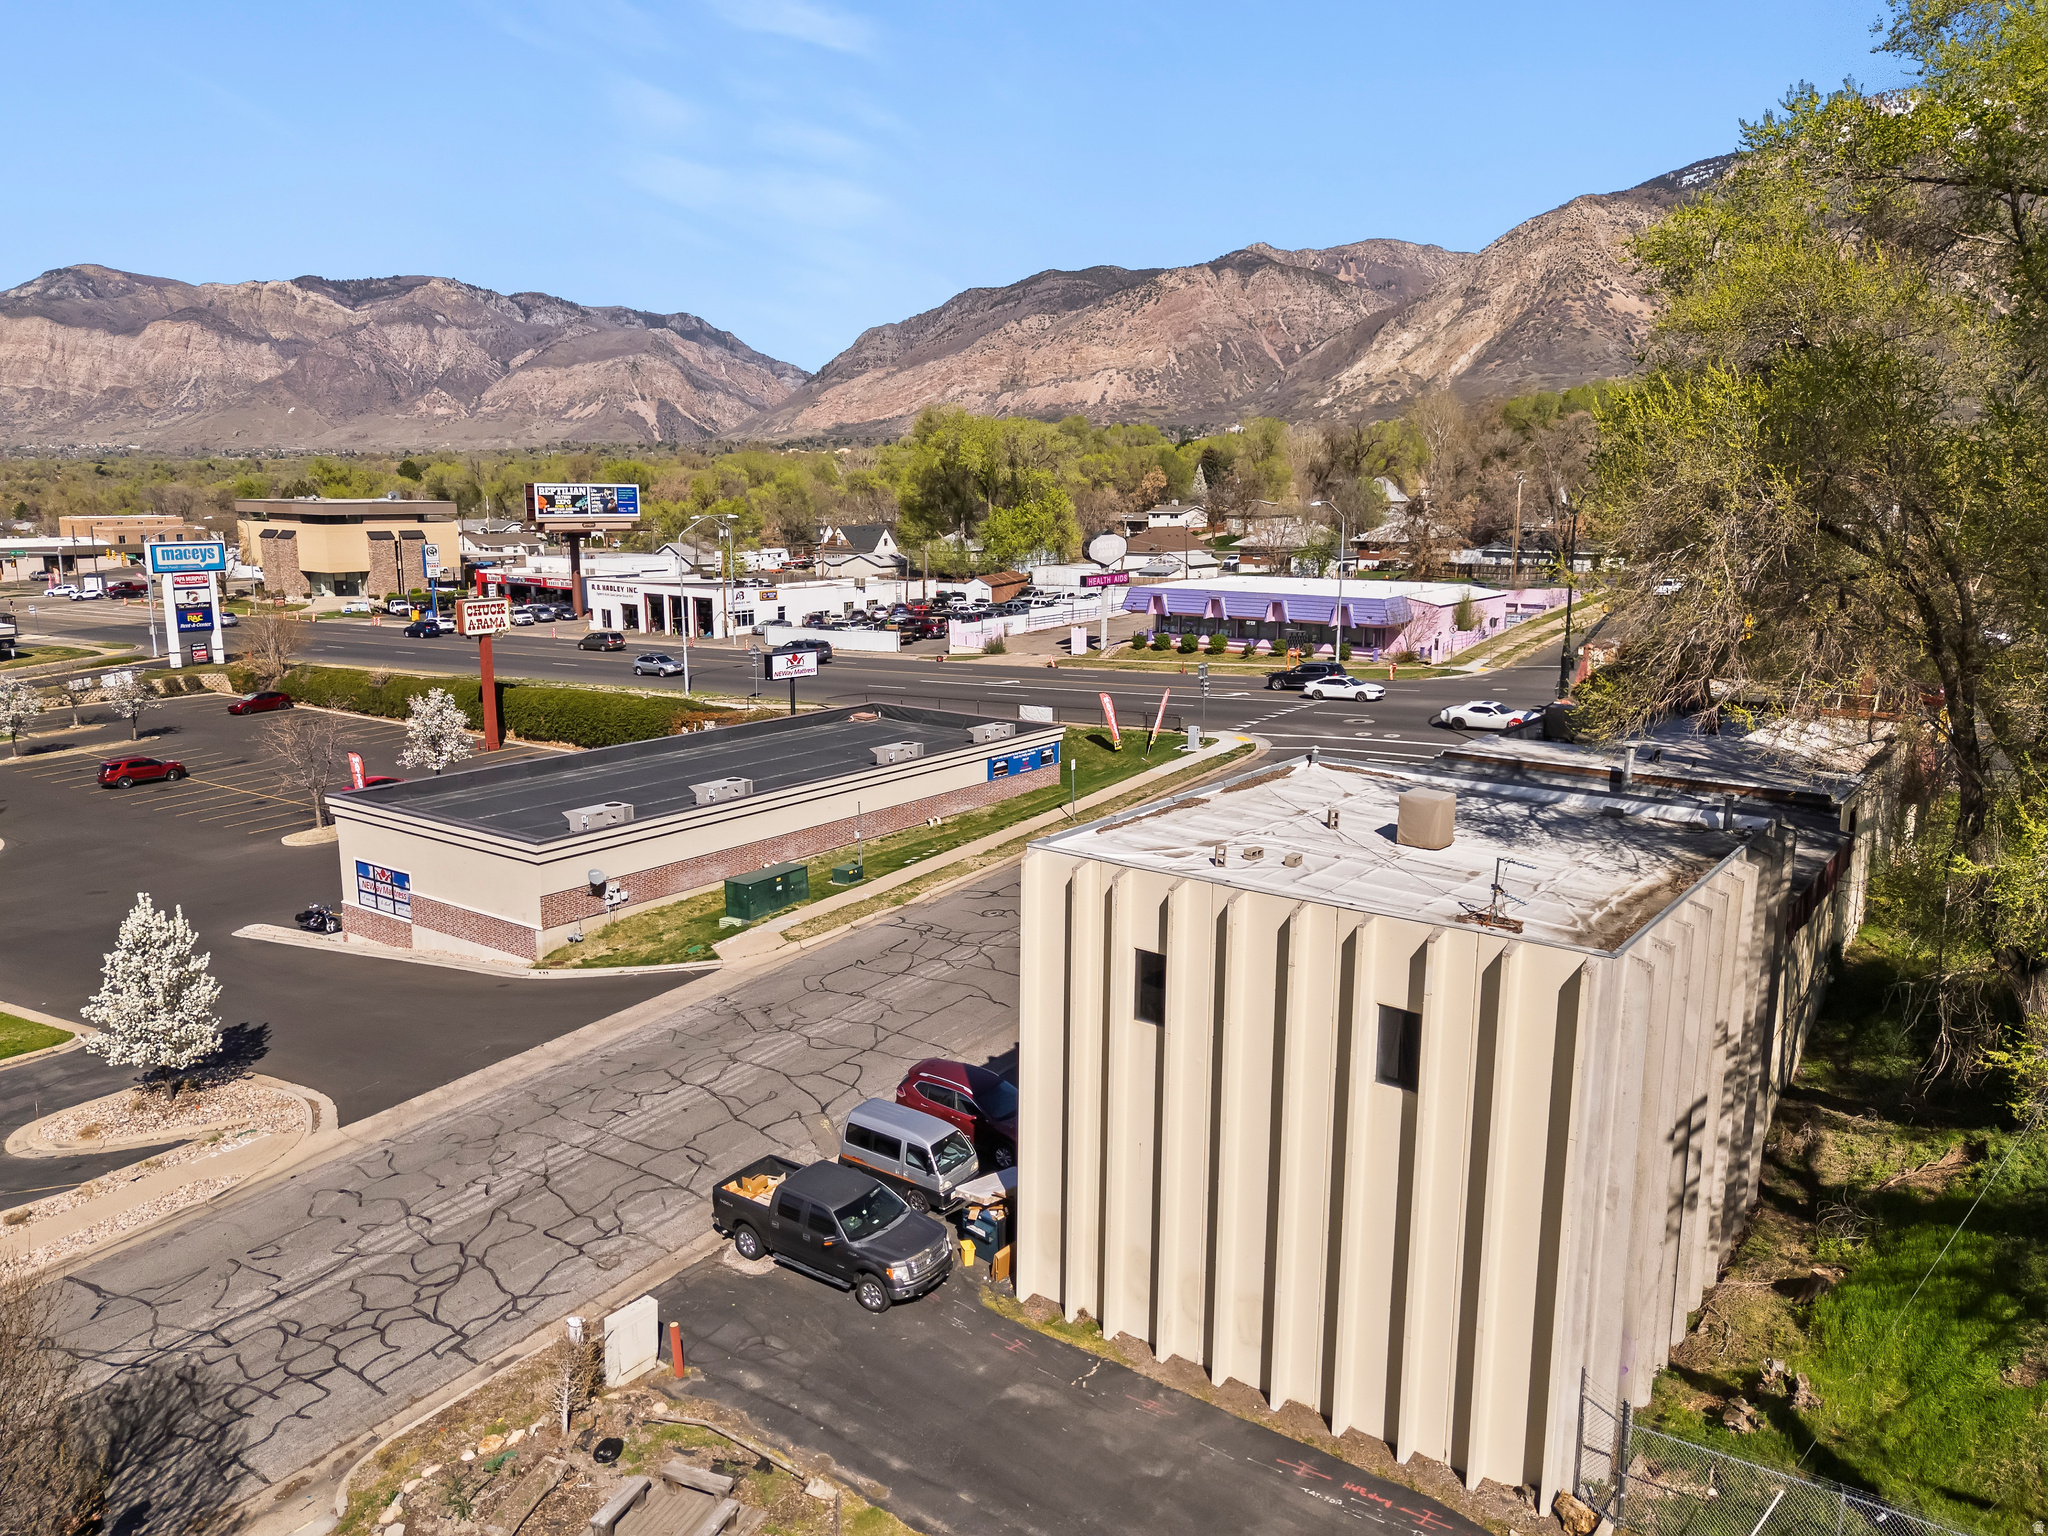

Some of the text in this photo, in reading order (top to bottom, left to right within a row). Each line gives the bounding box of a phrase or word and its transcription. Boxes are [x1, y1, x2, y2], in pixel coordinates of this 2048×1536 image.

[538, 487, 586, 495] REPTILIAN
[161, 547, 215, 562] maceys
[1088, 574, 1128, 586] HEALTH AIDS
[187, 614, 203, 622] RAC
